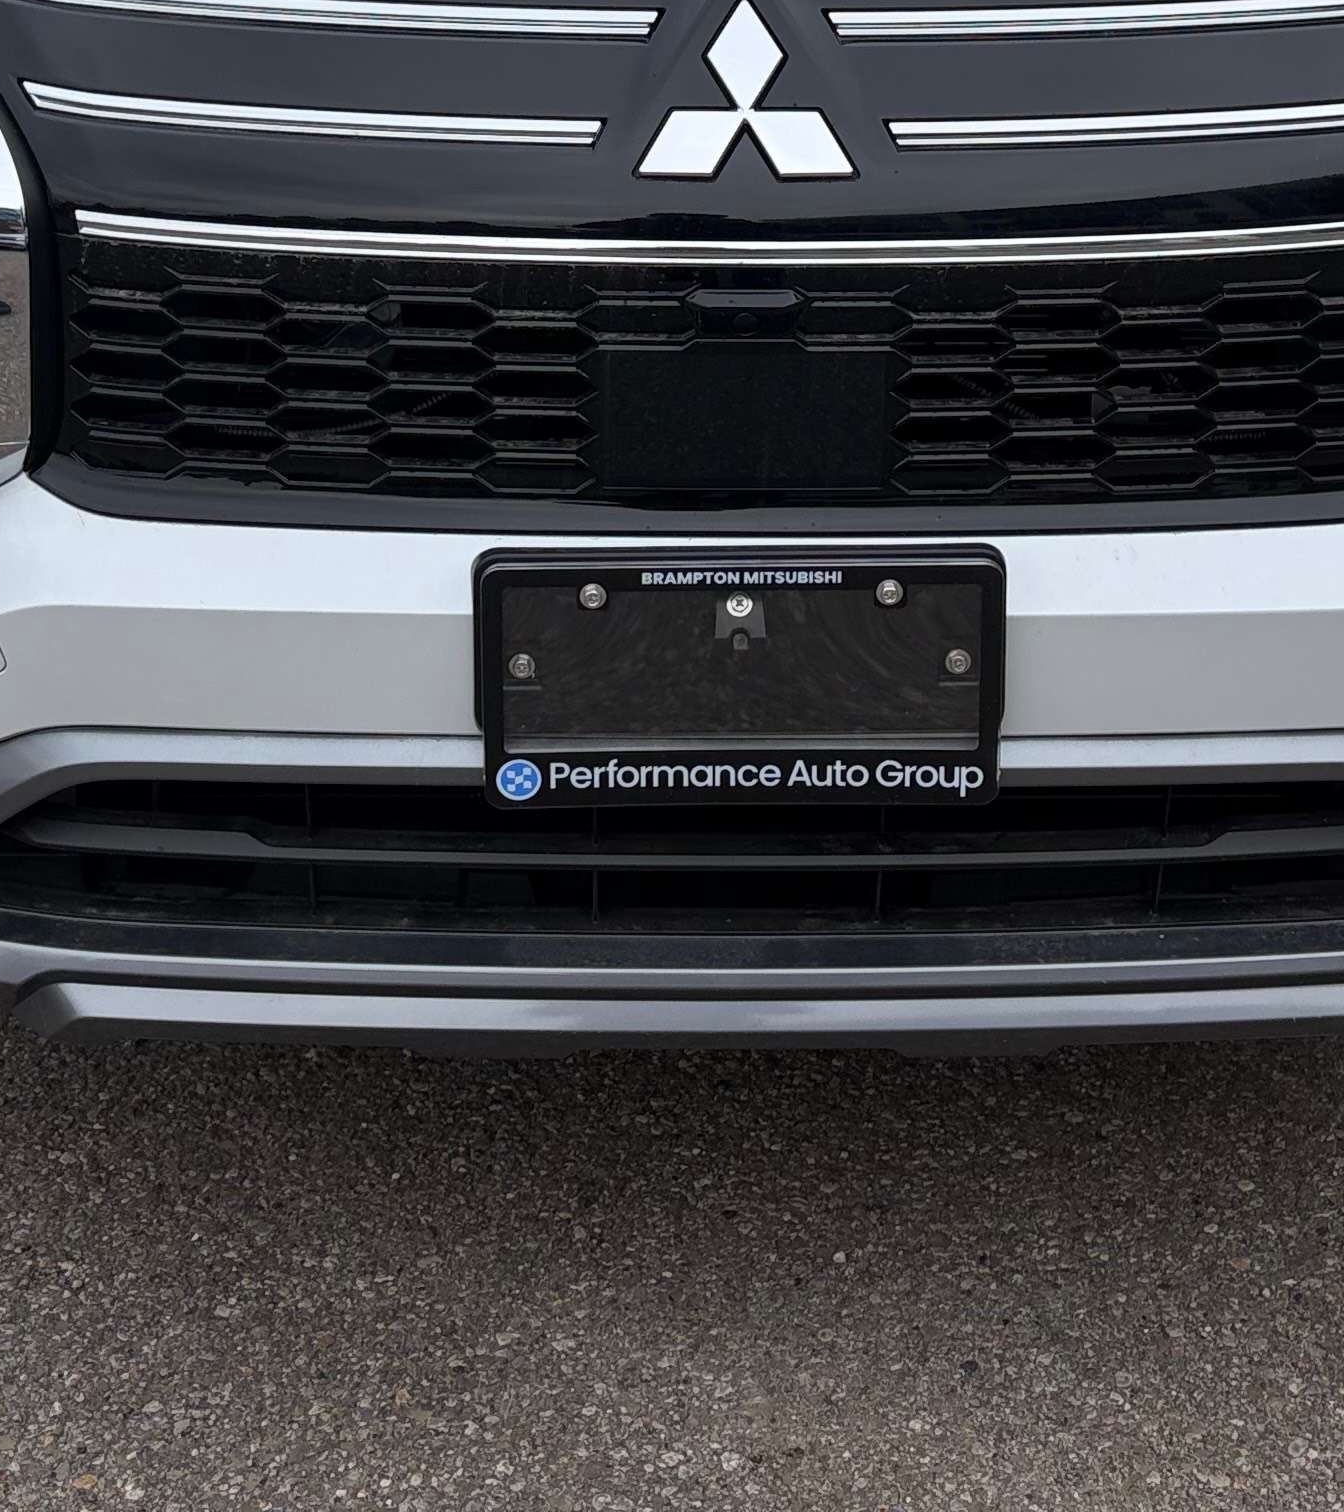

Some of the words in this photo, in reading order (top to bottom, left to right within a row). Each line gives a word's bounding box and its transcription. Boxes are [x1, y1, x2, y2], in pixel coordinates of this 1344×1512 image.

[641, 572, 740, 585] BRAMPTON
[743, 571, 843, 584] MITSUBISHI
[549, 759, 782, 789] Performance
[787, 759, 870, 787] Auto
[875, 760, 984, 797] Group
